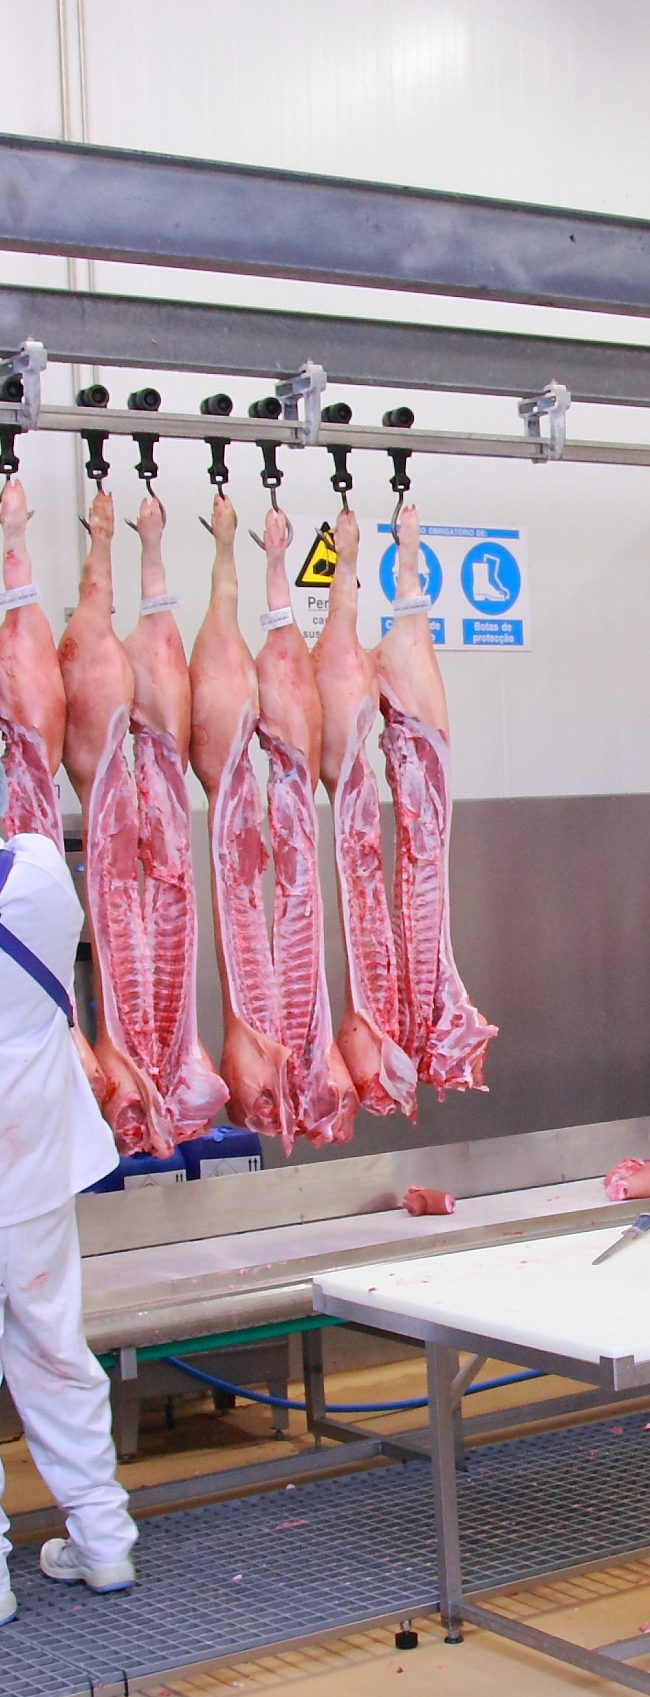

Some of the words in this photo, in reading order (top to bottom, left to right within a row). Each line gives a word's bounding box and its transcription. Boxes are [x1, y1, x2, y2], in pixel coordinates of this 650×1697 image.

[474, 621, 498, 632] Botas
[502, 621, 512, 632] de
[473, 632, 515, 645] protecção
